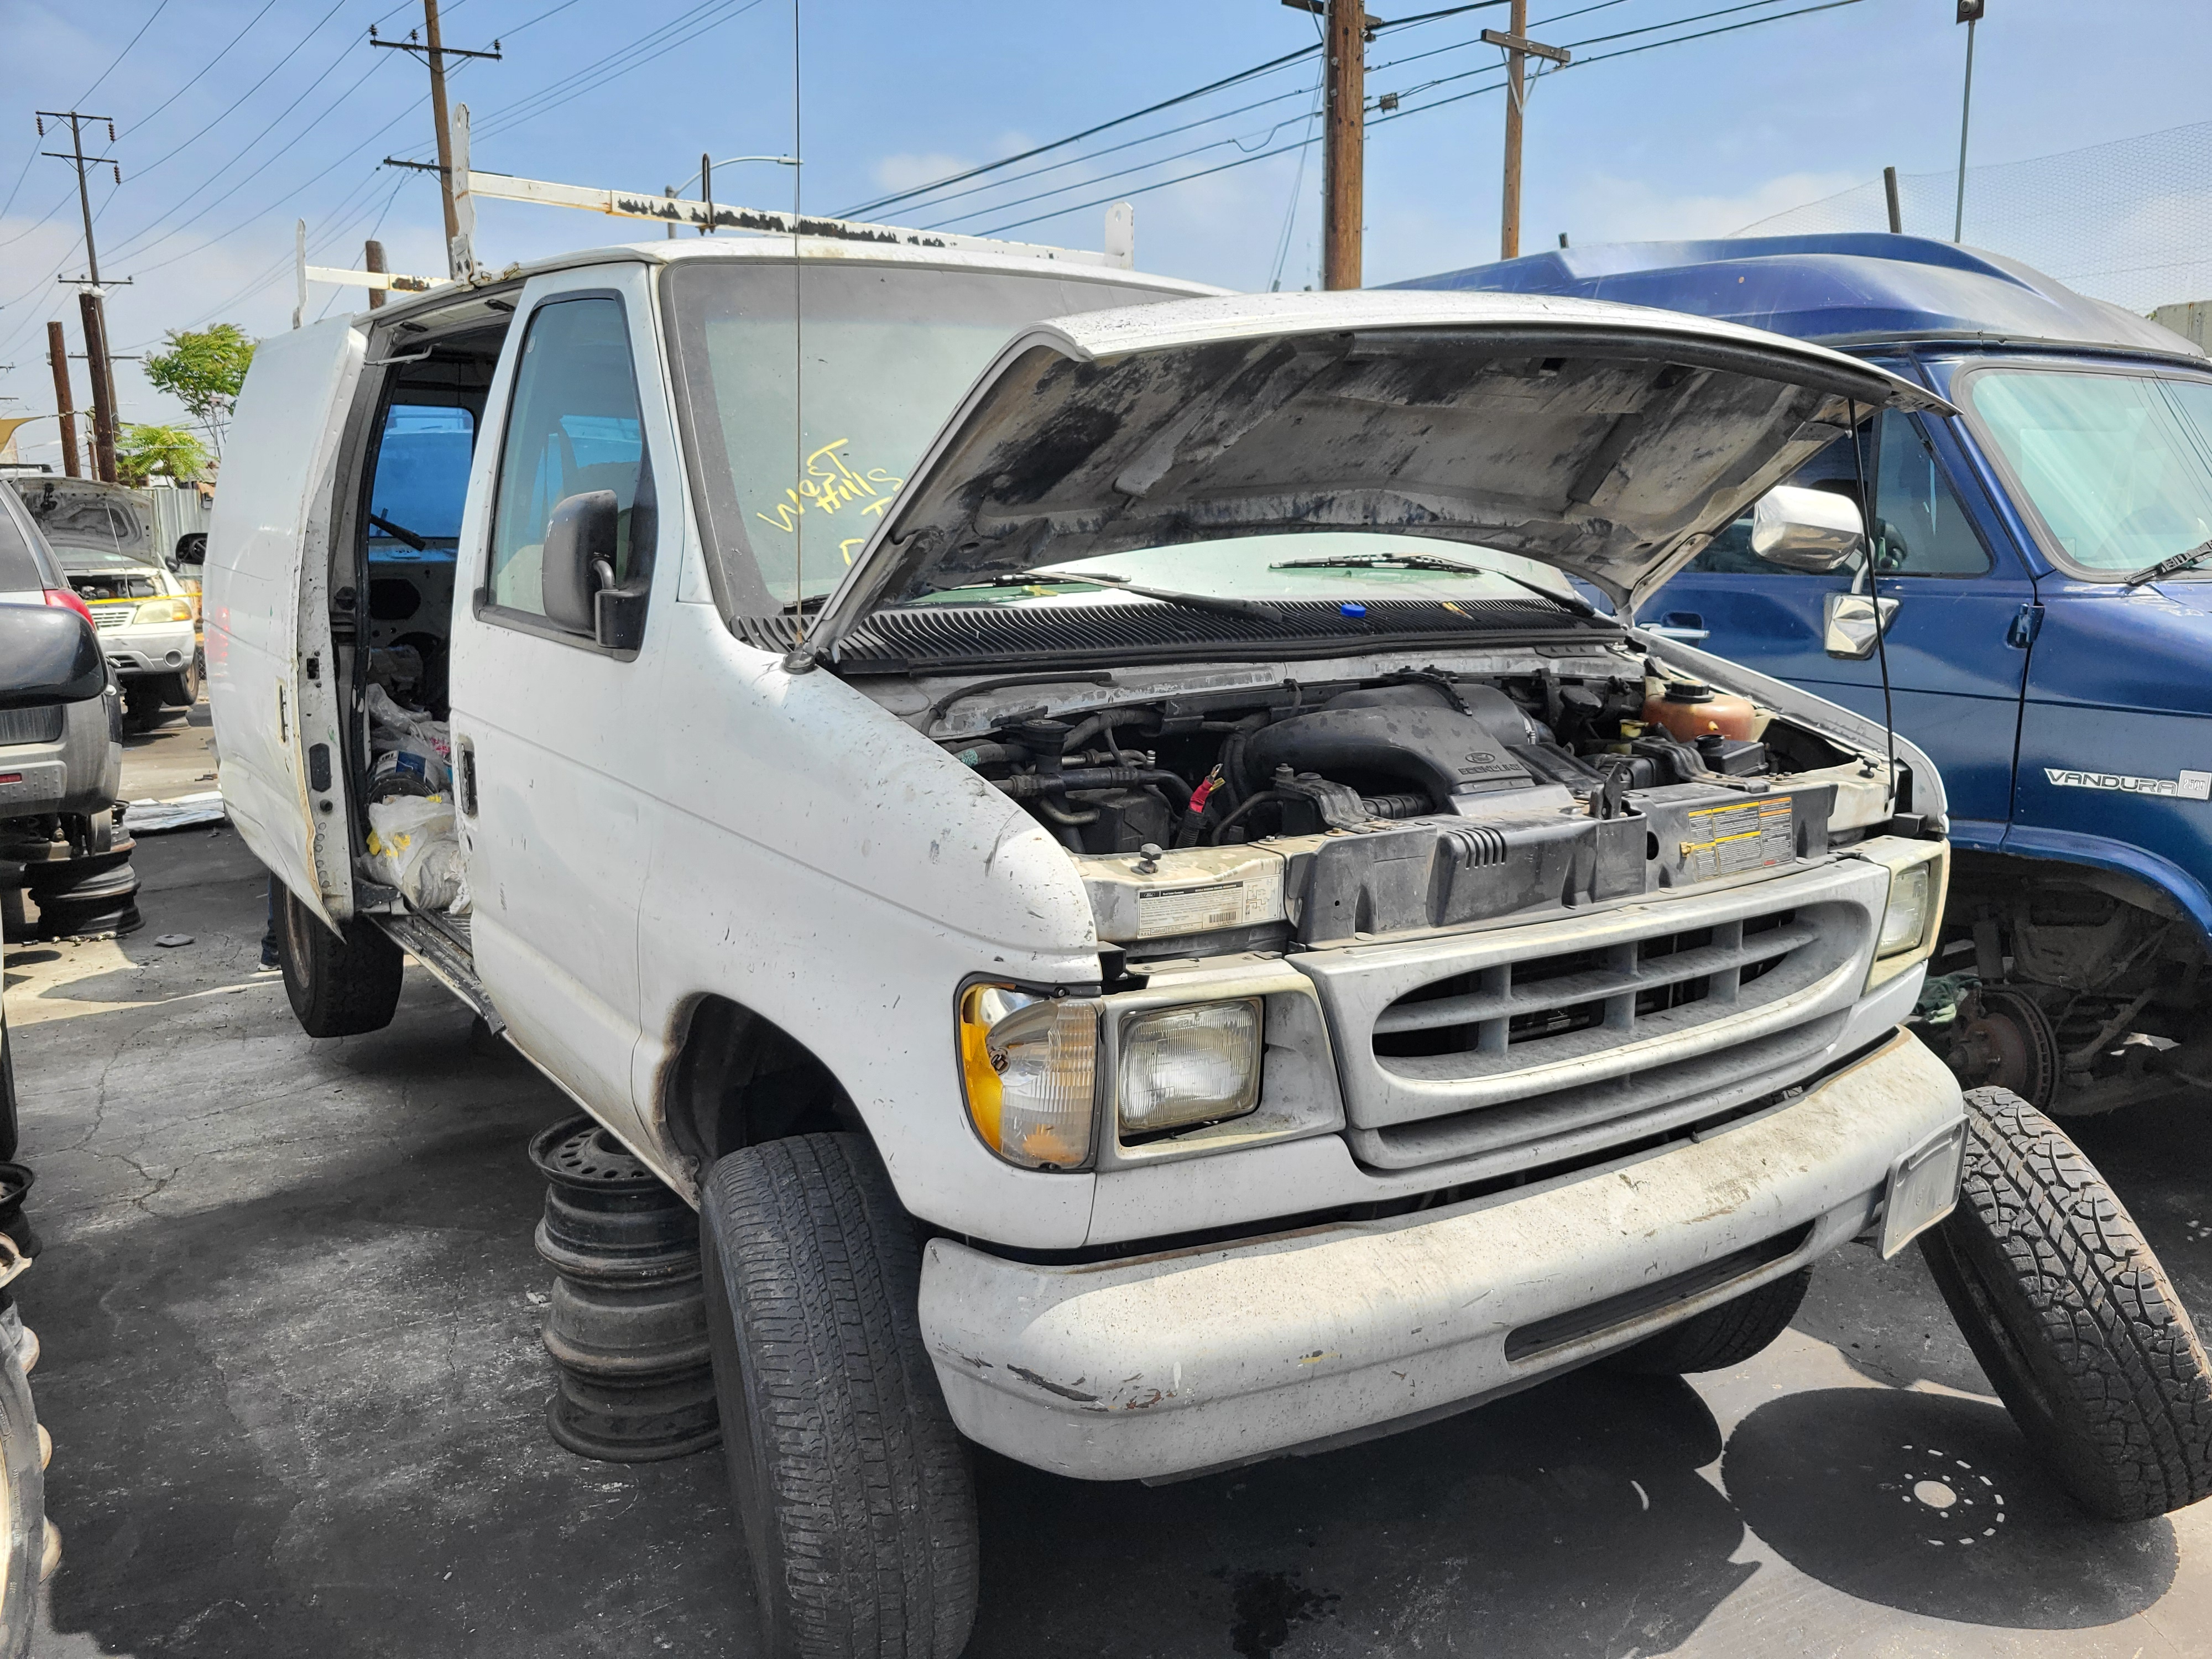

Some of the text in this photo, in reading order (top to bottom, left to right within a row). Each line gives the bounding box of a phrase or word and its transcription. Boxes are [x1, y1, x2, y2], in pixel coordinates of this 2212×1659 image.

[1458, 763, 1523, 775] ECONOLINE
[2047, 770, 2206, 795] VANDURA 2500
